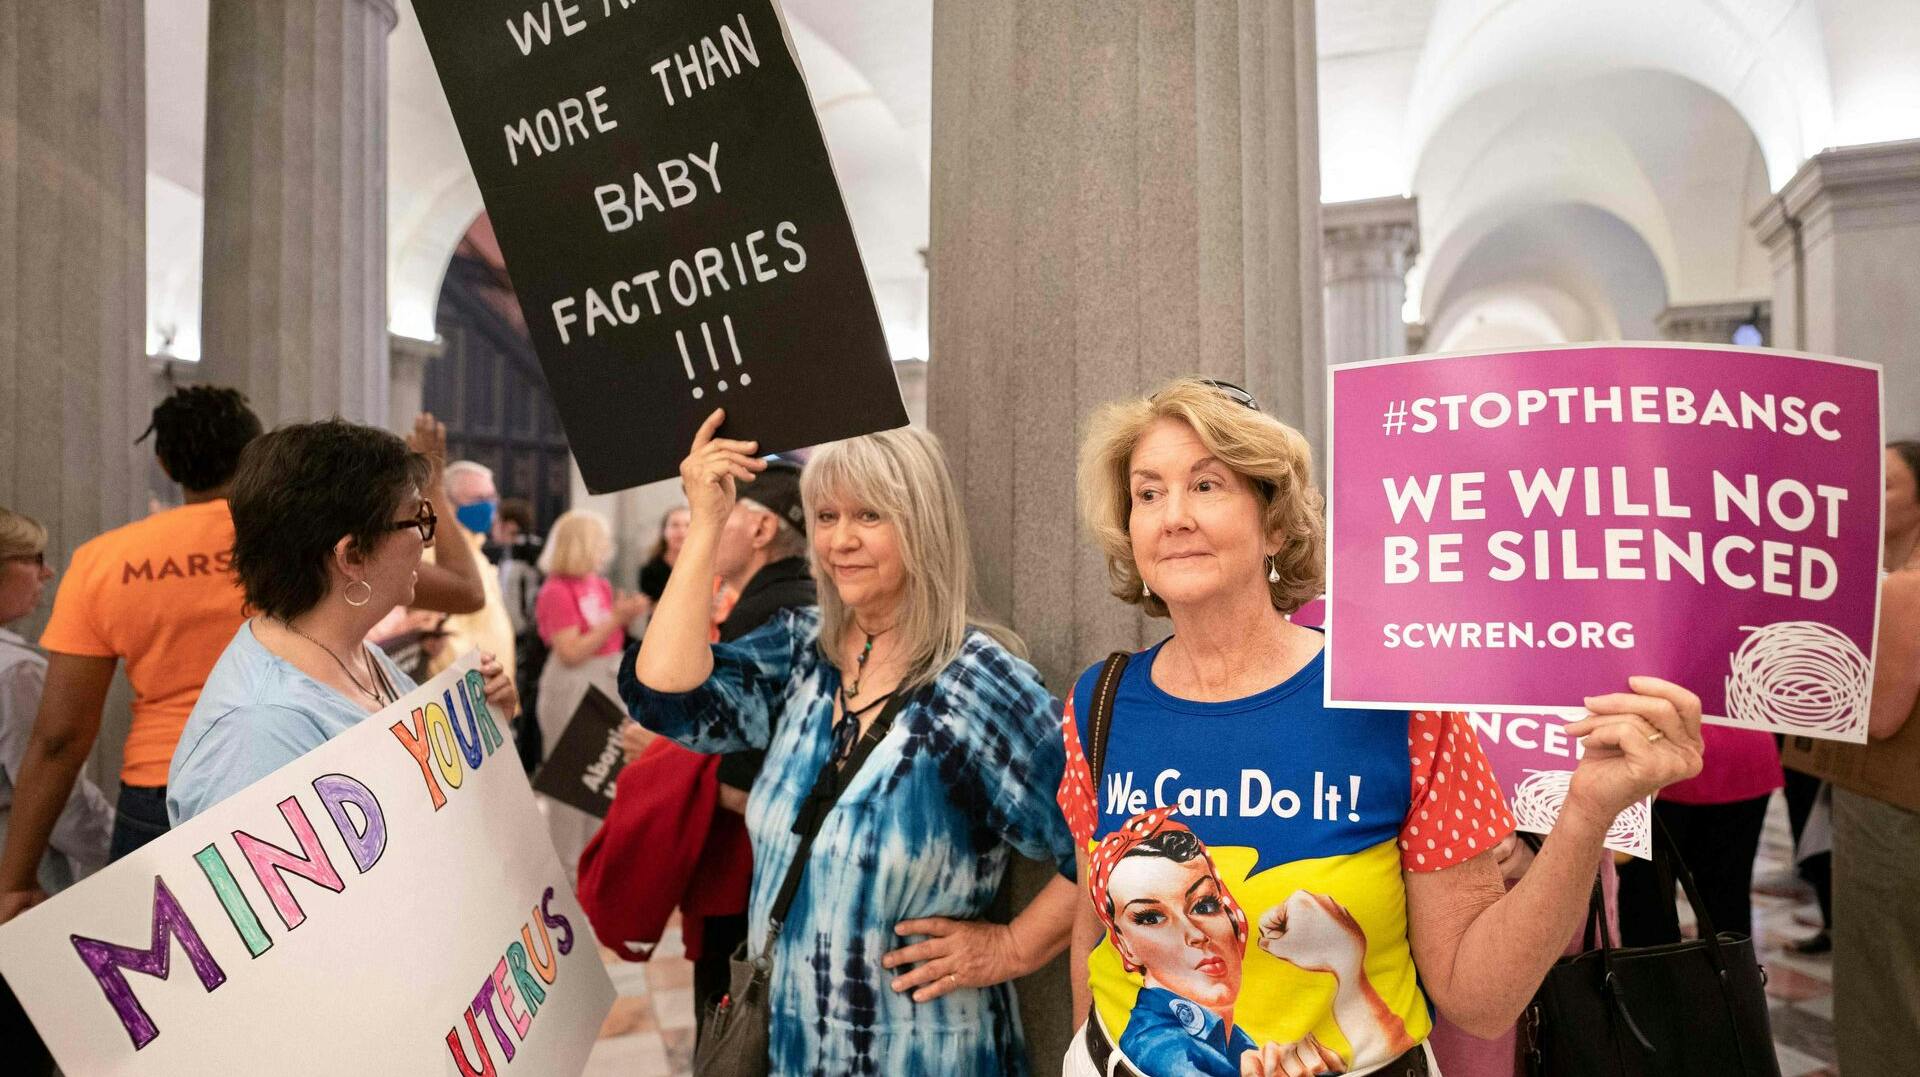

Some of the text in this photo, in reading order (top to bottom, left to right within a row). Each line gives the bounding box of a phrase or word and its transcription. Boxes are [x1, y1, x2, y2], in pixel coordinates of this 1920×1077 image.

[506, 0, 587, 56] WE
[504, 13, 760, 166] MORE THAN
[594, 142, 722, 233] BABY
[551, 221, 807, 345] FACTORIES
[675, 314, 752, 399] !!!
[1382, 387, 1842, 441] #STOPTHEBANSC
[1382, 467, 1849, 538] WE WILL NOT
[1384, 528, 1839, 601] BE SILENCED
[1383, 622, 1635, 649] SCWREN.ORG
[1468, 713, 1585, 760] NCE
[1106, 772, 1148, 815] We
[1154, 769, 1228, 817] Can
[1239, 769, 1301, 818] Do
[70, 669, 504, 1052] MIND YOUR
[445, 886, 574, 1077] UTERUS
